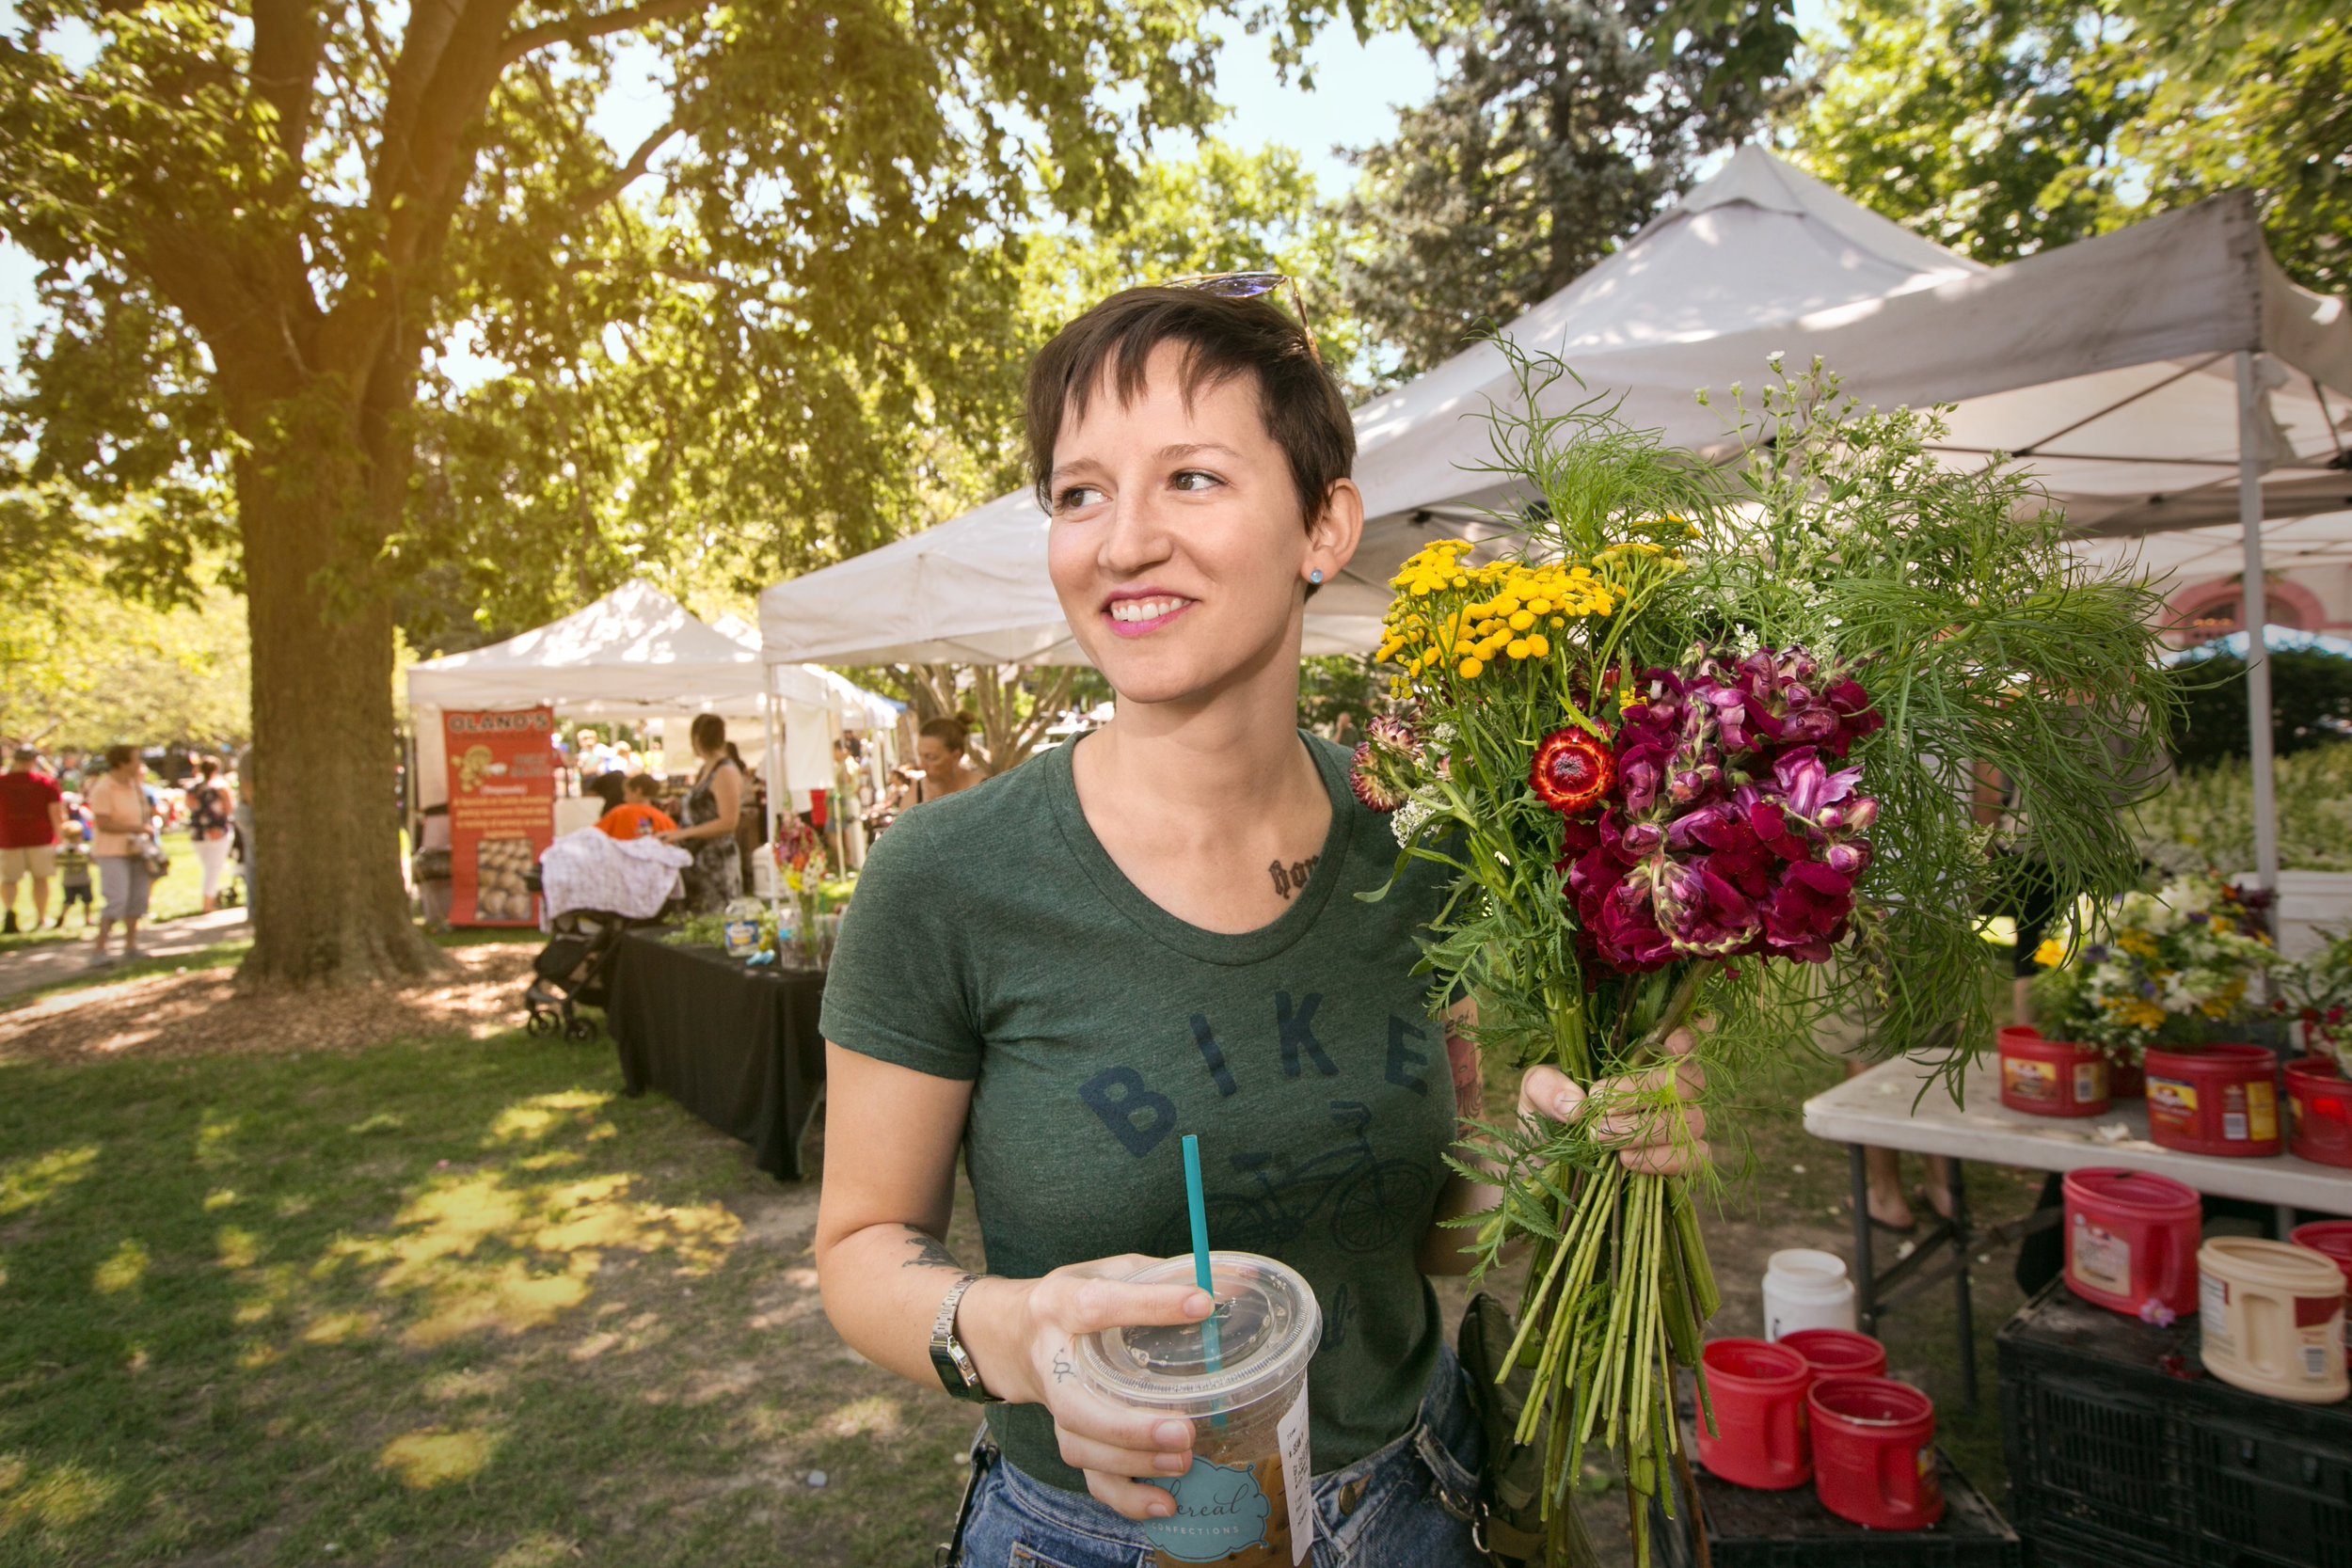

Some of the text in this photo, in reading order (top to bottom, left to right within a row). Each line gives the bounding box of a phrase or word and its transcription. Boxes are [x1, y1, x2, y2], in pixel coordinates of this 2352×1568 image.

[449, 712, 549, 733] OLANO'S
[1077, 990, 1429, 1159] BIKE
[1151, 1522, 1241, 1536] CONFECTIONS
